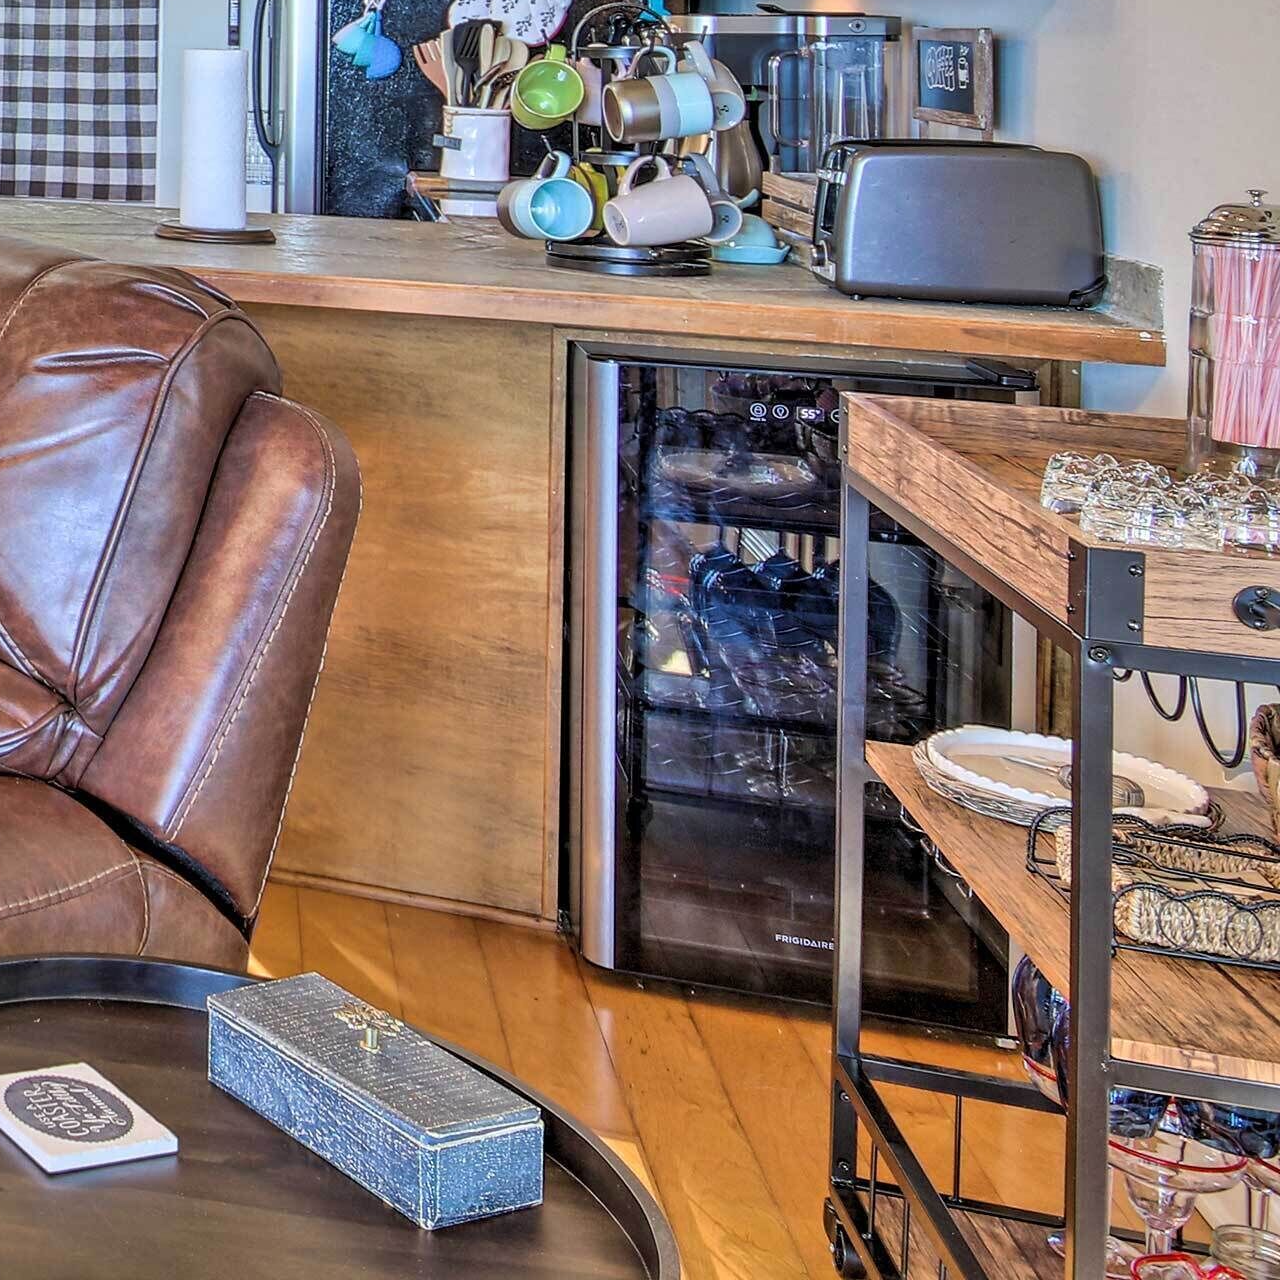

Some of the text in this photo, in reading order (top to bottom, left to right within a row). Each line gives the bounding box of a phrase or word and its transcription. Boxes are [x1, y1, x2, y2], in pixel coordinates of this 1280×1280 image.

[775, 933, 834, 951] FRIGIDAIRE
[26, 1103, 57, 1129] USE A
[82, 1112, 110, 1133] Ya
